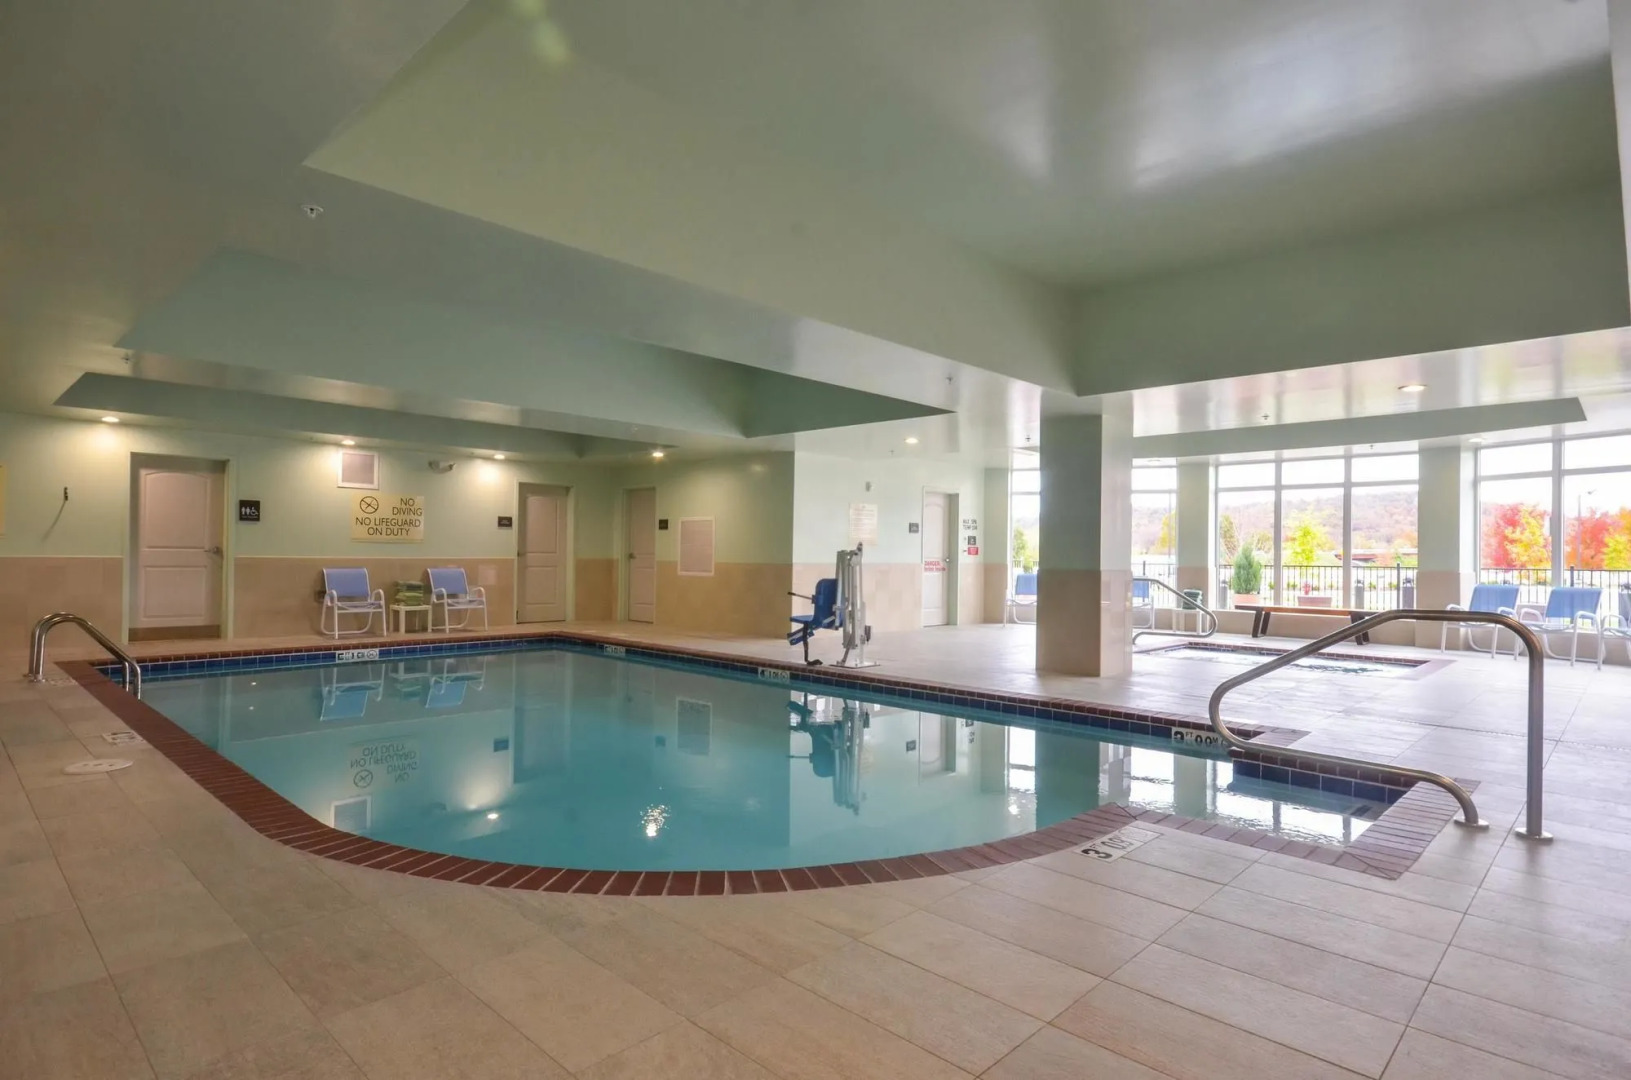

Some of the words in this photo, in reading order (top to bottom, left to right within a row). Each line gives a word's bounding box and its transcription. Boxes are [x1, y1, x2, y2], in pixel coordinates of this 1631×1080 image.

[400, 498, 415, 507] NO
[392, 507, 423, 516] DIVING
[355, 517, 372, 526] NO
[374, 517, 421, 528] LIFEGUARD
[367, 526, 383, 536] ON
[385, 527, 410, 536] DUTY
[1081, 848, 1113, 859] 3
